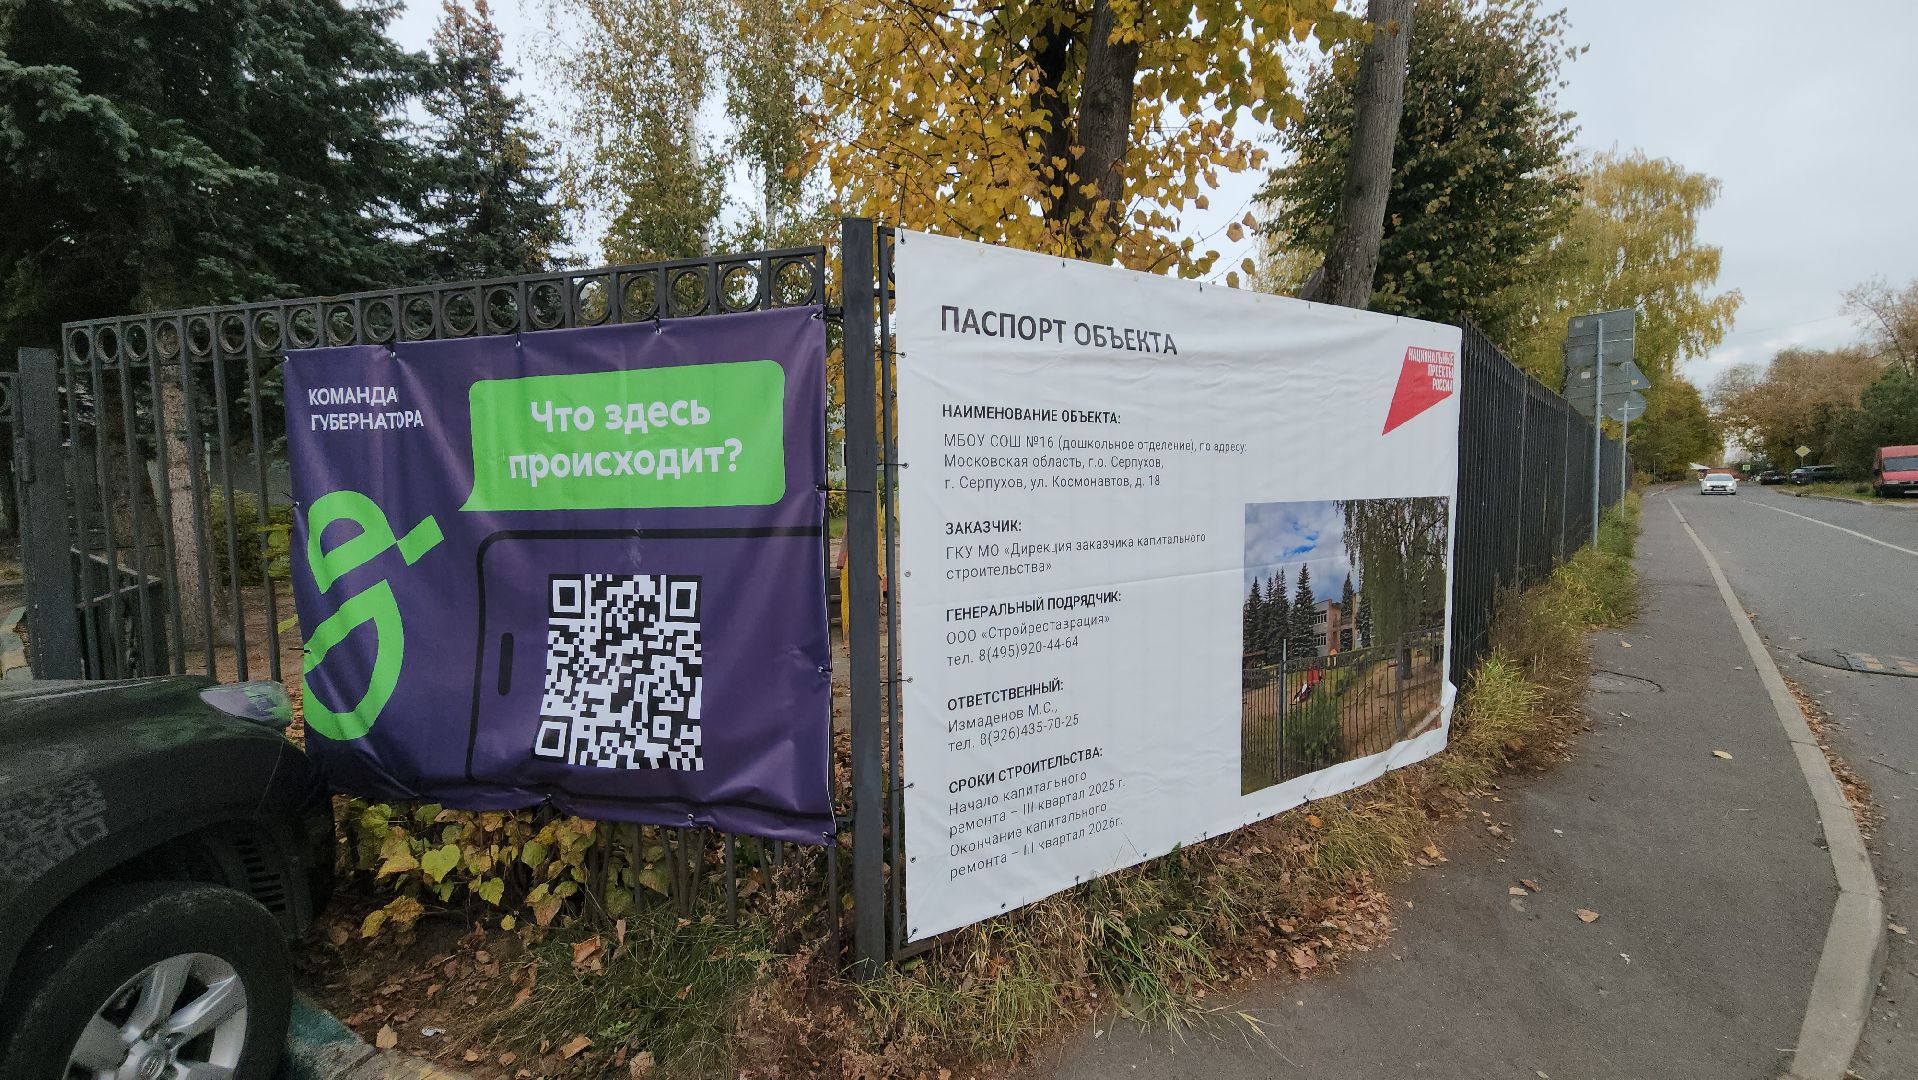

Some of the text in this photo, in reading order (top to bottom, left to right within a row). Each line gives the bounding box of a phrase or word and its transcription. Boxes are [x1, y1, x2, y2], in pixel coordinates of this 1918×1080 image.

[941, 304, 1178, 356] ПАСПОРТ ОБЪЕКТА
[308, 386, 398, 407] КОМАНДА
[311, 410, 425, 431] ГУБЕРНАТОРА
[530, 399, 711, 435] Что здесь
[942, 403, 1121, 424] НАИМЕНОВАНИЕ ОБЪЕКТА:
[944, 433, 985, 447] МБОУ
[990, 434, 1021, 448] СОШ
[1026, 435, 1054, 449] №16
[1058, 435, 1135, 452] (дошкольное
[509, 438, 743, 487] происходит?
[944, 453, 1028, 468] Московская
[1032, 454, 1085, 469] область,
[1110, 455, 1164, 471] Серпухов,
[944, 474, 1161, 492] г. Серпухов, ул. Космонавтов, д. 18
[945, 519, 1022, 535] ЗАКАЗЧИК:
[946, 545, 973, 560] ГКУ
[978, 543, 999, 557] МО
[1076, 538, 1134, 551] заказчика
[1137, 533, 1206, 547] капитального
[946, 562, 1052, 582] строительства»
[946, 590, 1122, 622] ГЕНЕРАЛЬНЫЙ ПОДРЯДЧИК:
[946, 629, 977, 645] ООО
[947, 653, 974, 667] тел.
[947, 677, 1064, 711] ОТВЕТСТВЕННЫЙ:
[948, 709, 1024, 733] Измаденов
[948, 738, 975, 752] тел.
[949, 746, 1103, 794] СРОКИ СТРОИТЕЛЬСТВА:
[949, 794, 999, 816] Начало
[949, 811, 1006, 839] ремонта
[1038, 789, 1085, 811] квартал
[1088, 778, 1115, 798] 2025
[950, 803, 1108, 857] Окончание капитального
[950, 853, 1007, 881] ремонта
[1038, 827, 1085, 850] квартал
